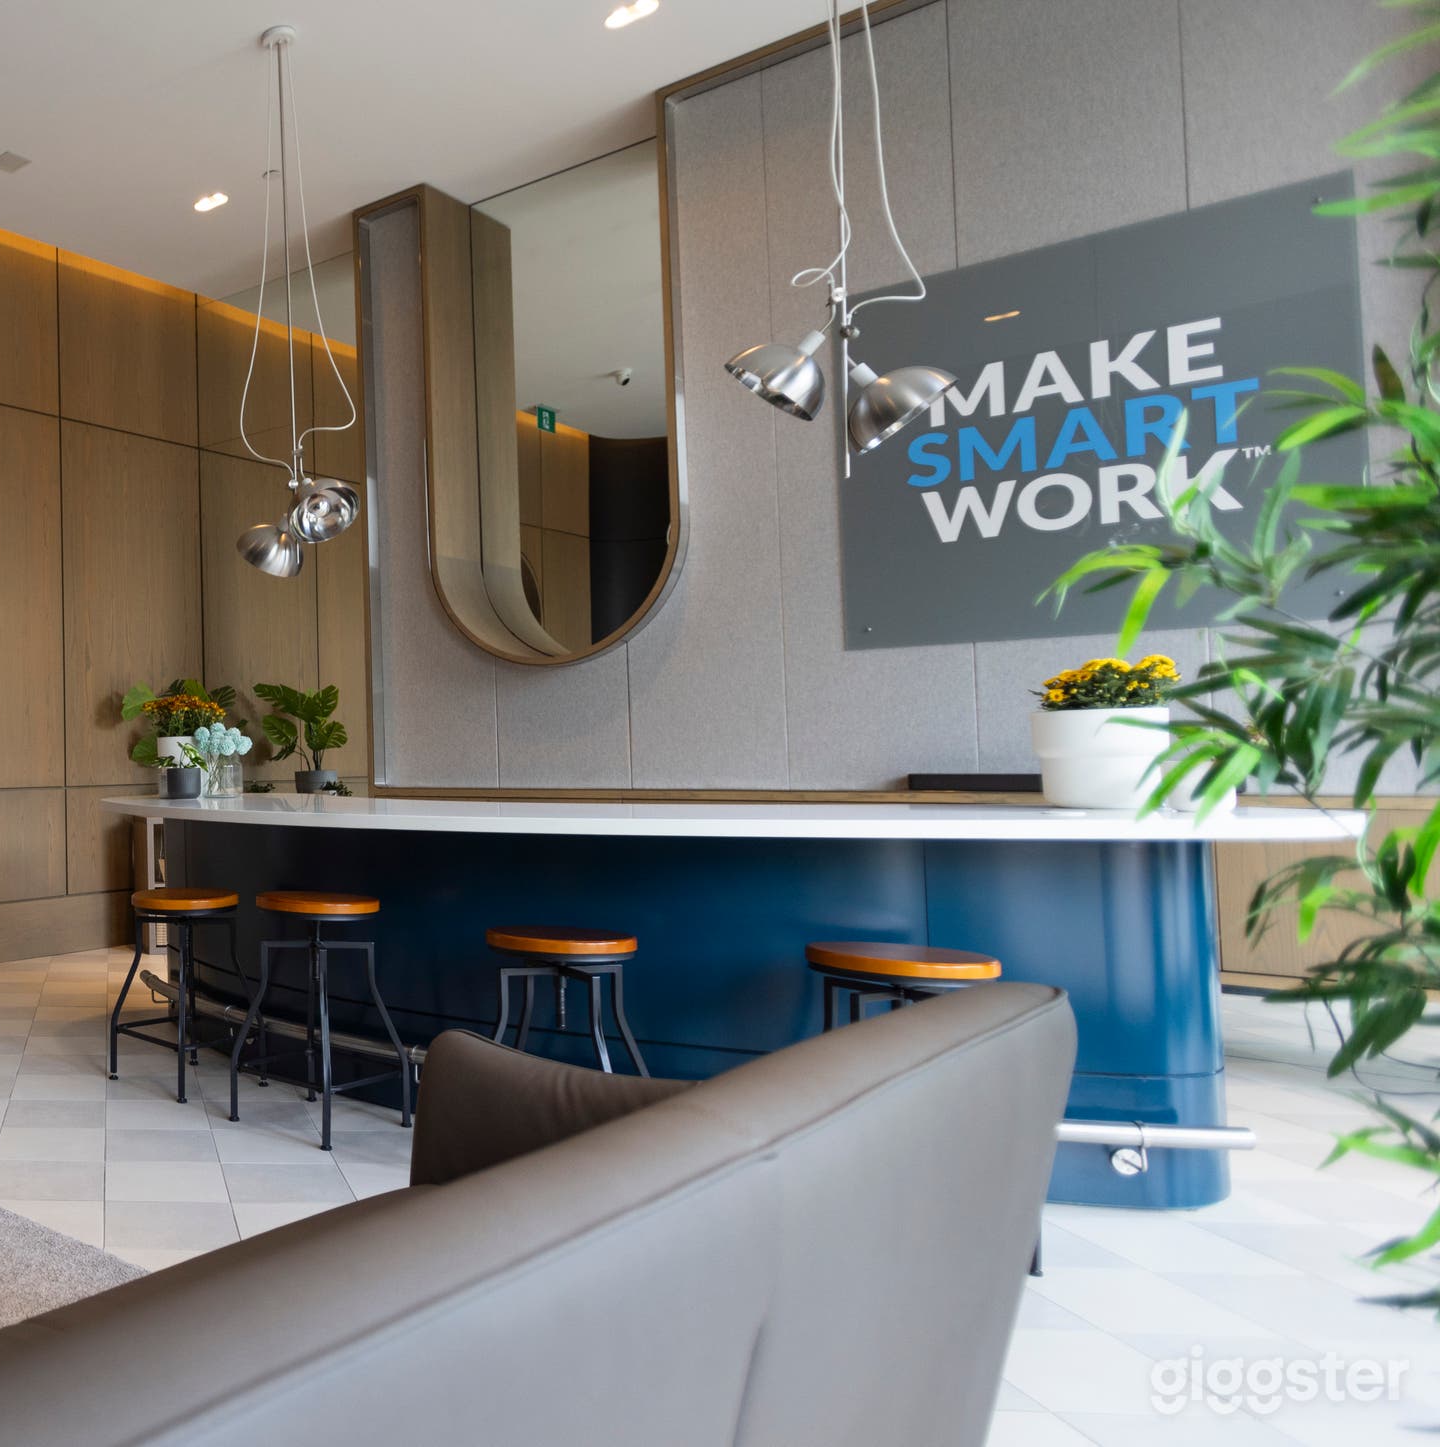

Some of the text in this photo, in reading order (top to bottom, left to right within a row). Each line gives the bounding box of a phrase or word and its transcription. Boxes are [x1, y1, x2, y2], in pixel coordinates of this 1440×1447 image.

[929, 317, 1223, 427] MAKE
[907, 377, 1259, 488] SMART
[921, 448, 1244, 543] WORK
